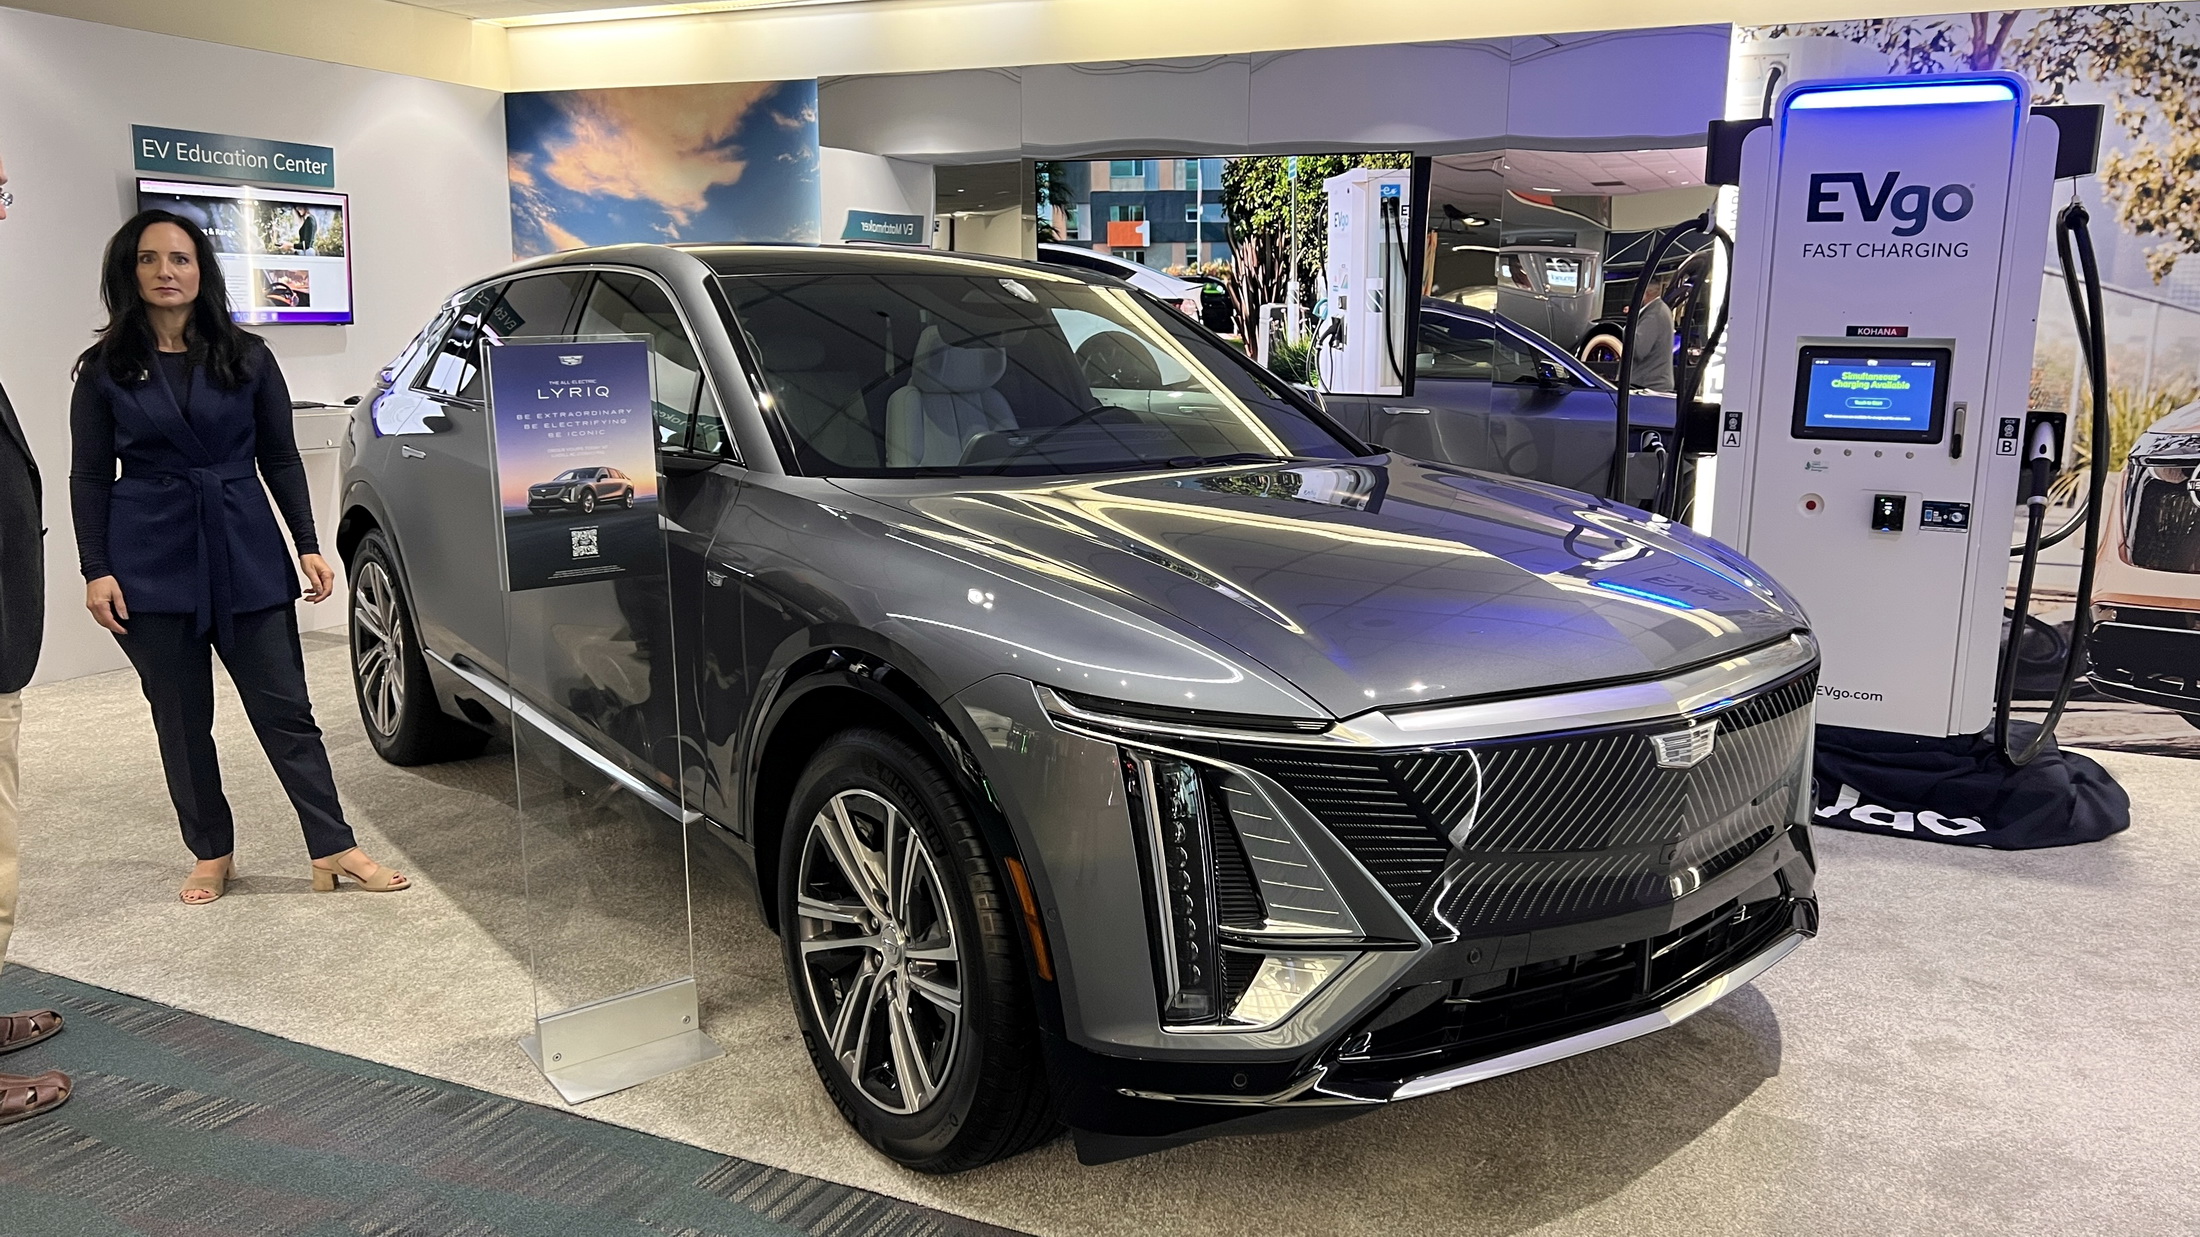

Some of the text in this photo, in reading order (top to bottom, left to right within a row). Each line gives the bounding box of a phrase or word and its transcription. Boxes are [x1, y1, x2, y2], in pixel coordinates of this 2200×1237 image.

[142, 139, 328, 175] EV Education Center
[1806, 171, 1974, 237] EVgo
[1334, 211, 1349, 231] EVgo
[1803, 242, 1969, 258] FAST CHARGING
[1857, 328, 1897, 336] KOHANA
[1831, 380, 1911, 390] Charging Available
[537, 385, 610, 400] LYRIQ
[536, 408, 632, 420] EXTRAORDINARY
[543, 418, 627, 429] ELECTRIFYING
[567, 429, 606, 437] ICONIC
[1726, 433, 1737, 445] A
[2002, 440, 2012, 452] B
[1817, 685, 1883, 702] EVgo.com
[879, 767, 943, 853] MICHELIN
